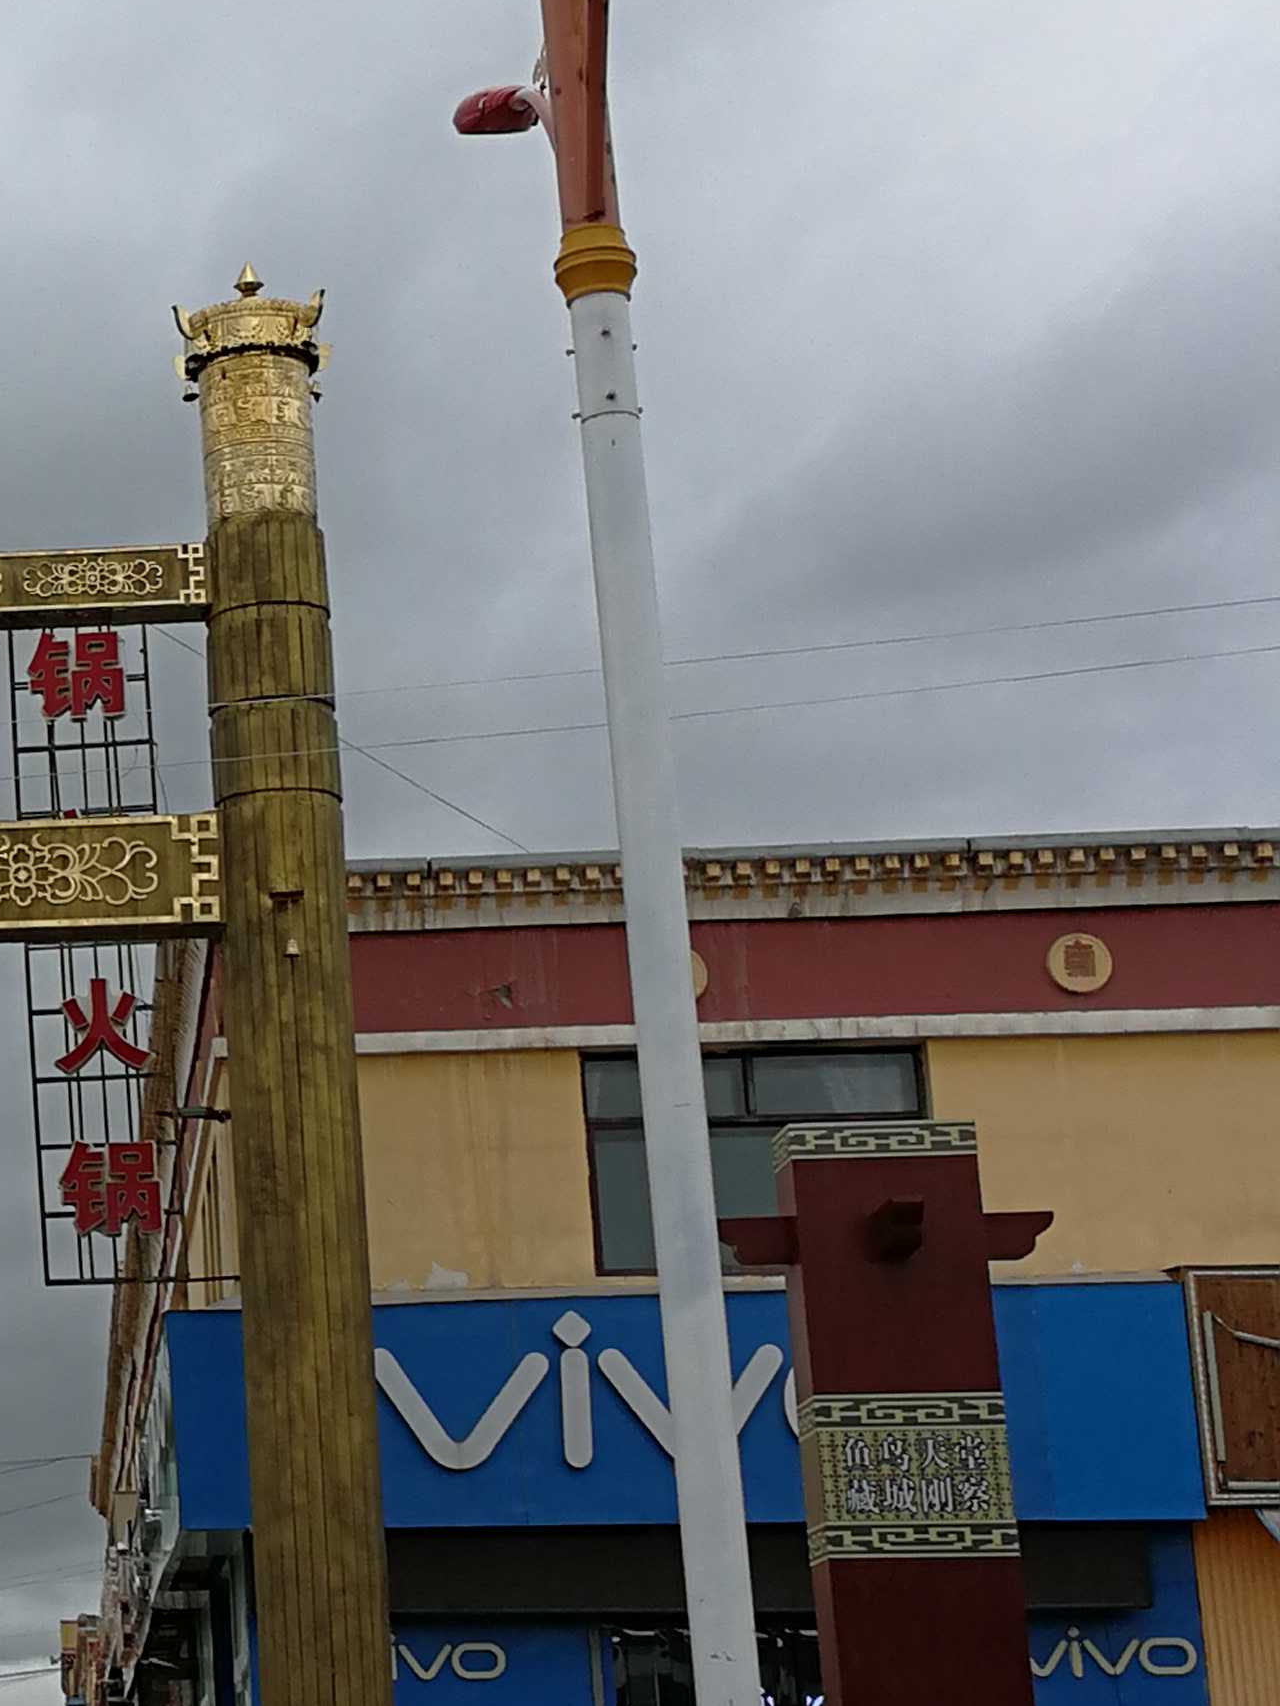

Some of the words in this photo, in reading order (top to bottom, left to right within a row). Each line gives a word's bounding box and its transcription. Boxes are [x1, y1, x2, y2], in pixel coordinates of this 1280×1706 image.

[374, 1309, 800, 1469] viv
[844, 1434, 989, 1472] 鱼鸟天堂
[846, 1476, 990, 1514] 藏城刚察
[390, 1633, 507, 1681] ivo
[1030, 1626, 1198, 1678] vivo
